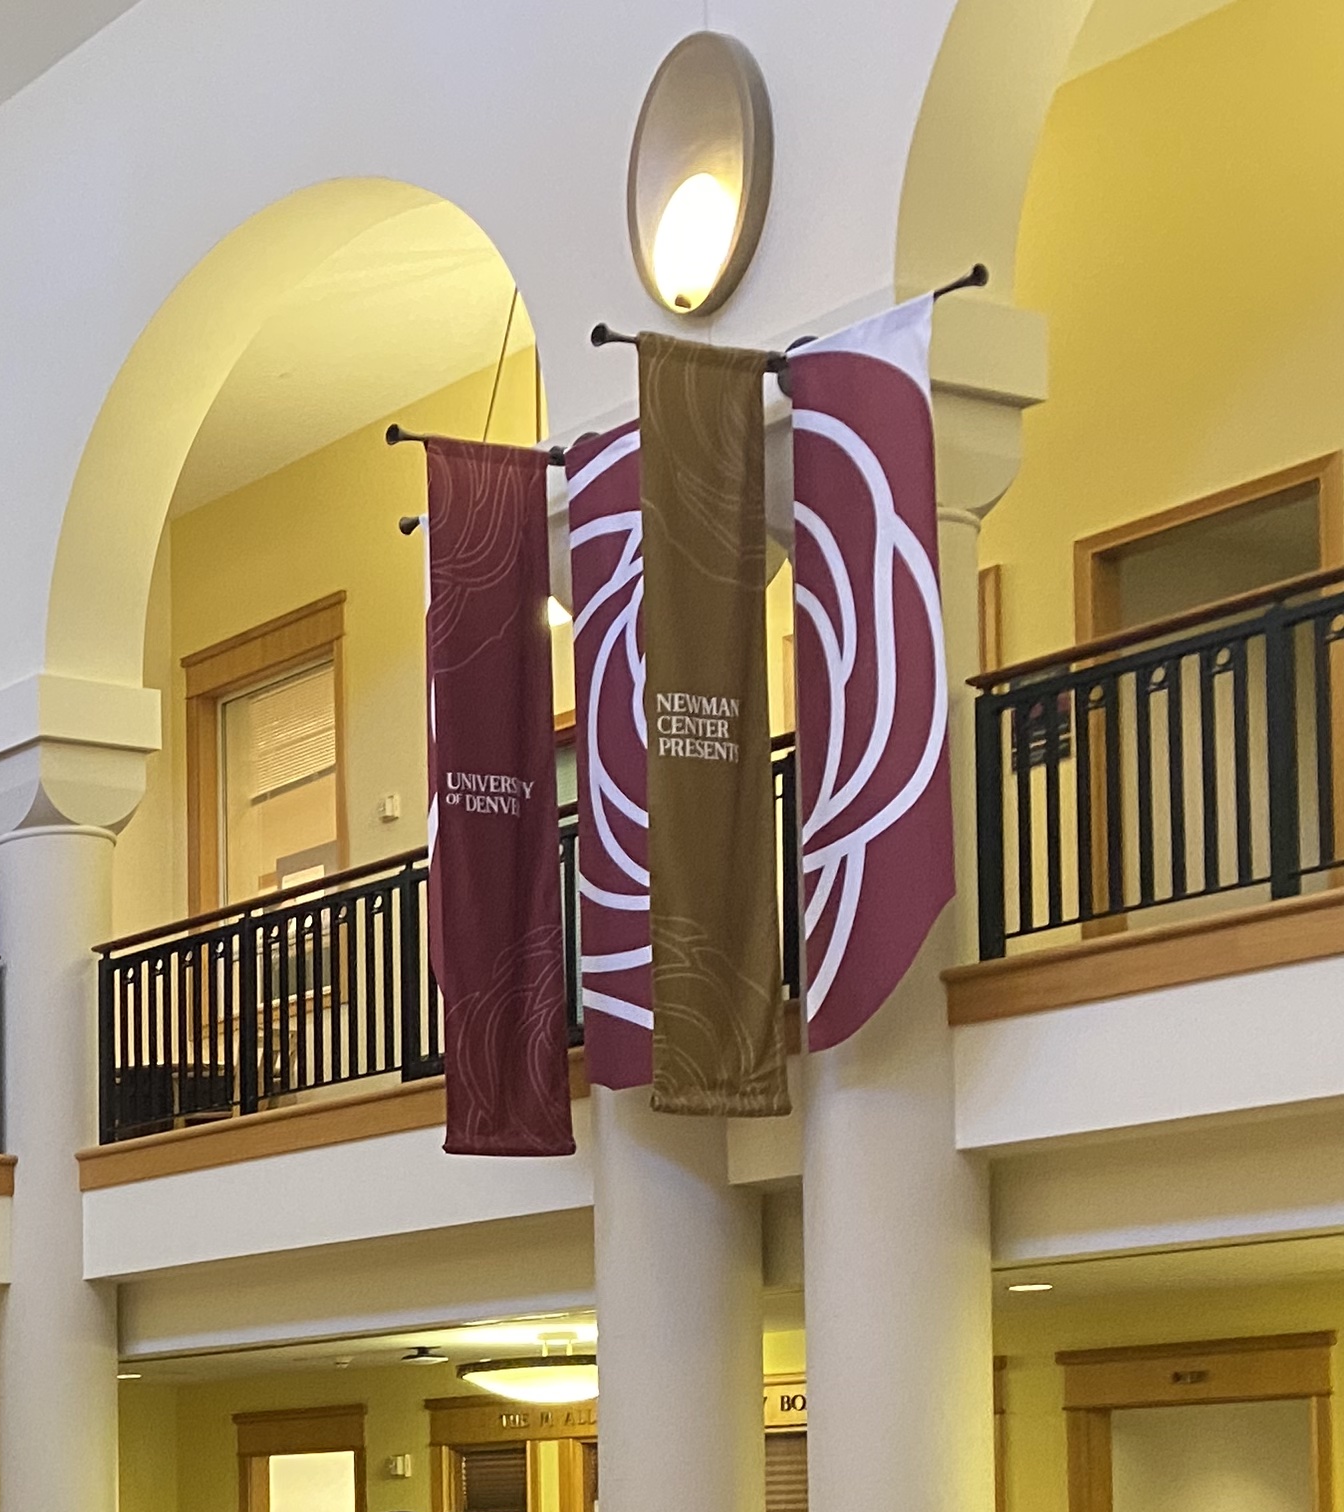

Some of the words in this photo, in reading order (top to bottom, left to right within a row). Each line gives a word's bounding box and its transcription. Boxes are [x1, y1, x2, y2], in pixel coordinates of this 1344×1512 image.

[656, 693, 739, 718] NEWMAN
[656, 716, 729, 739] CENTER
[446, 793, 463, 806] OF
[780, 1394, 807, 1411] BO
